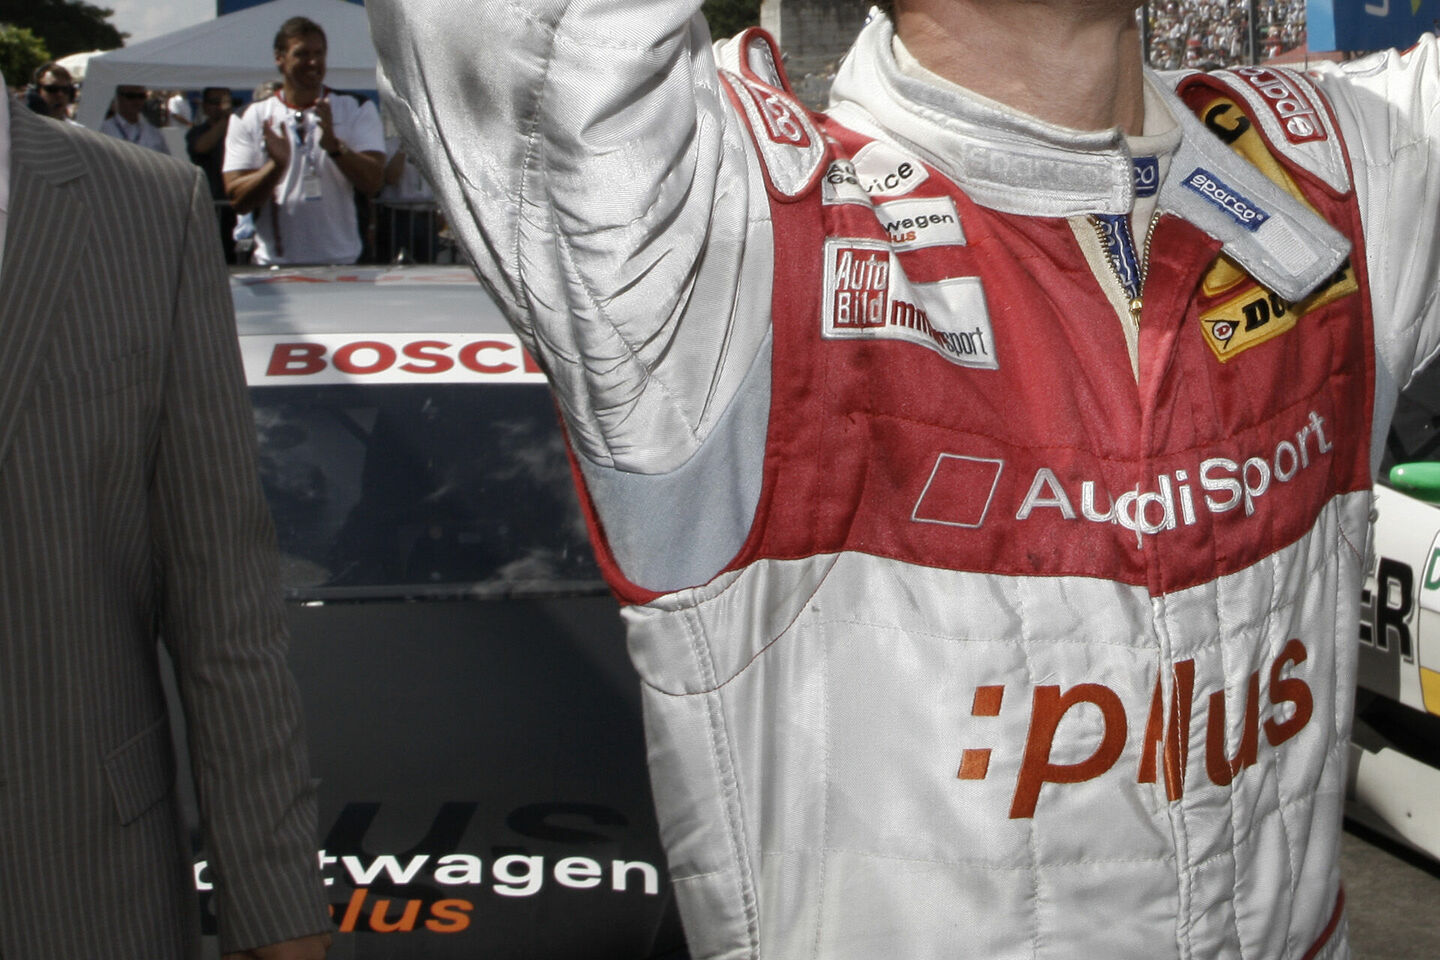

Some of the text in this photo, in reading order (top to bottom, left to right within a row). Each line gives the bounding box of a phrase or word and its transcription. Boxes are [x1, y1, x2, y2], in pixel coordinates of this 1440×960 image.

[835, 250, 889, 291] Auto
[836, 291, 884, 325] Bild
[265, 340, 546, 377] BOSC
